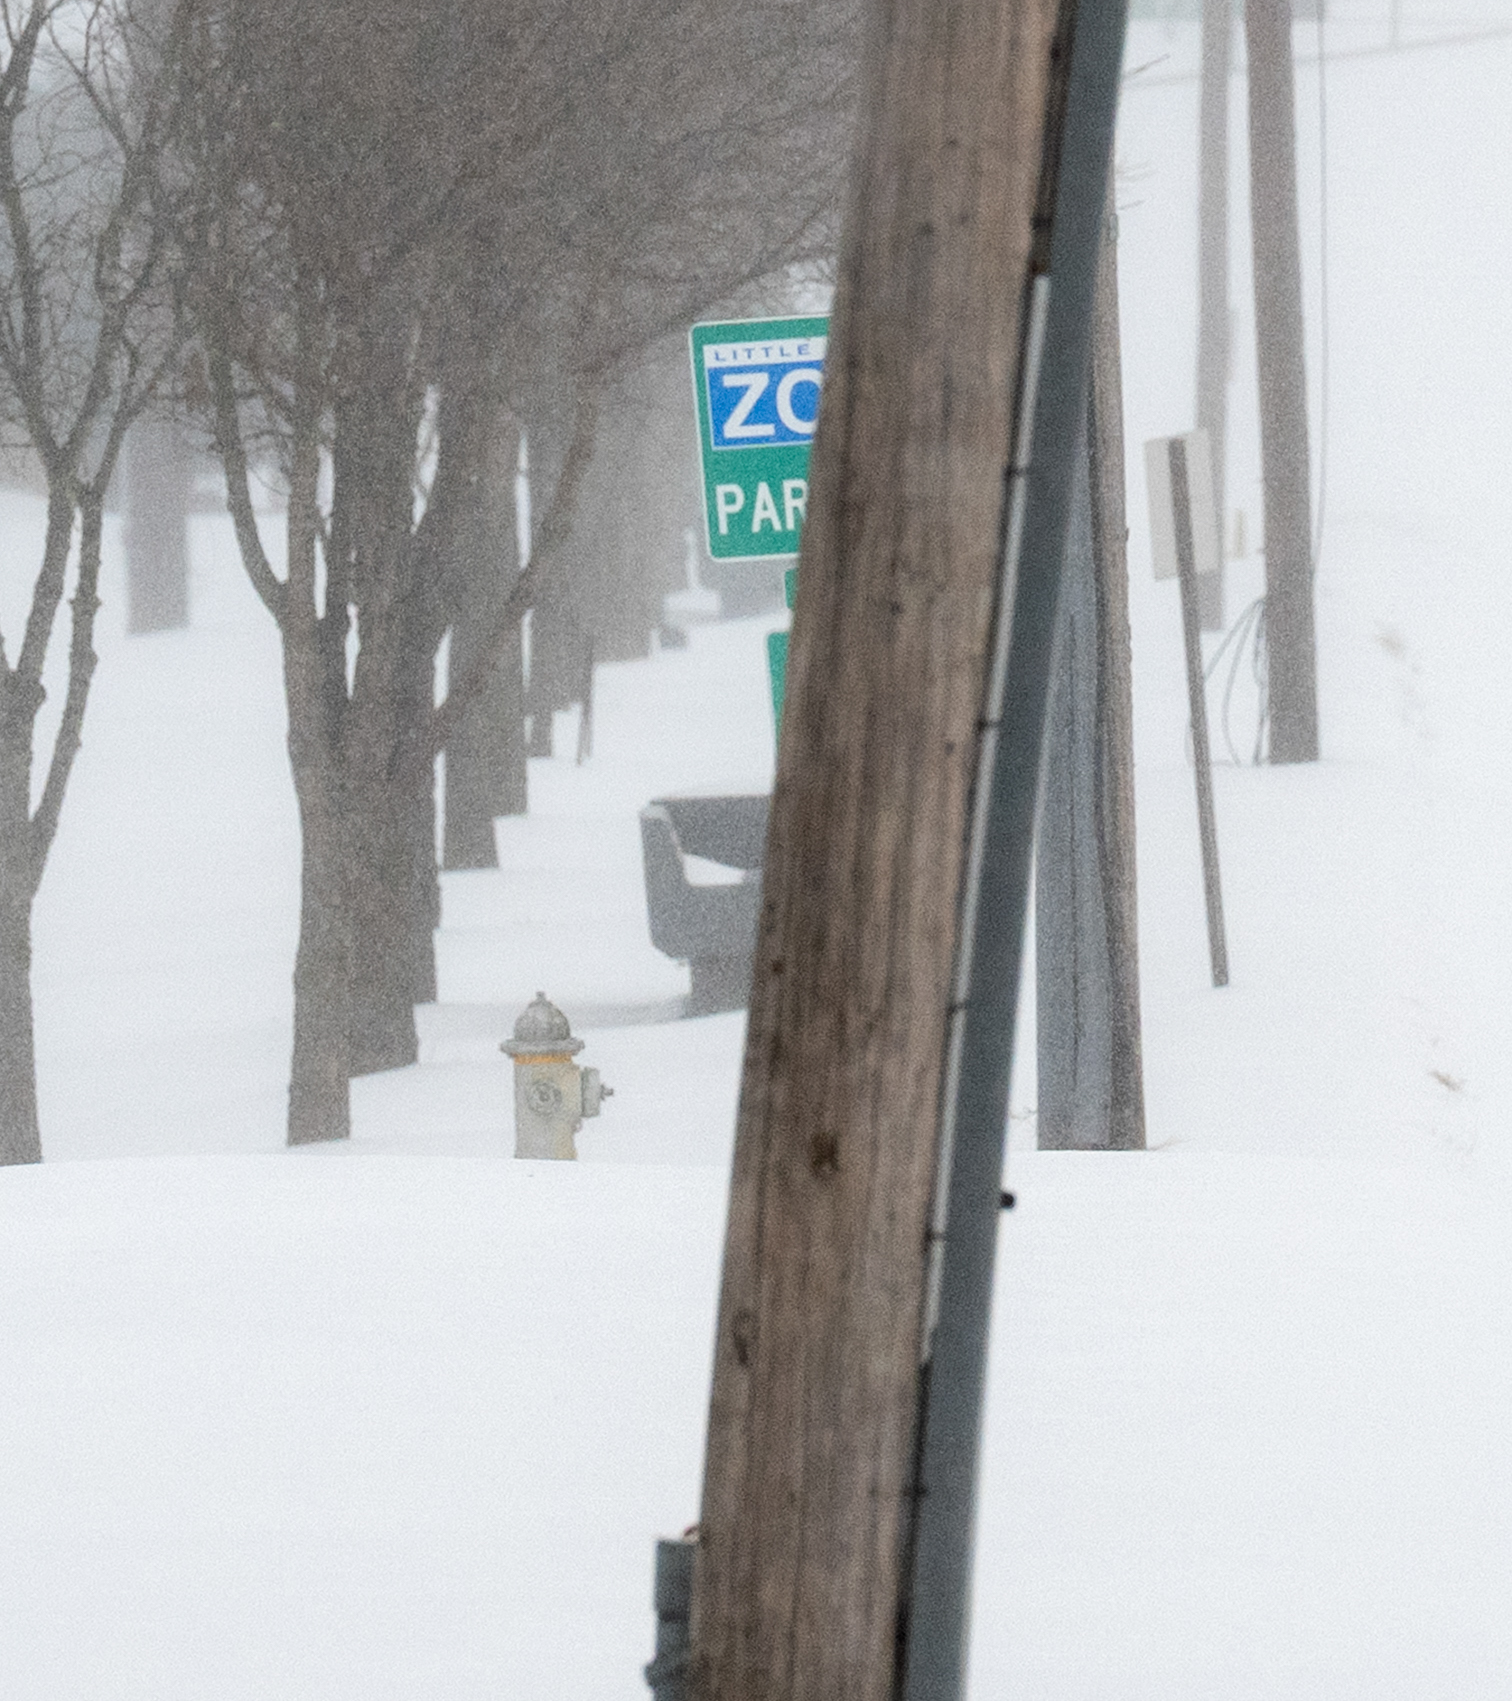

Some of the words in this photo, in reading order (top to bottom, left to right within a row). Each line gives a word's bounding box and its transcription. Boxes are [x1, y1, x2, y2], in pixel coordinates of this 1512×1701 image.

[714, 343, 811, 362] LITTLE
[722, 368, 824, 440] ZO
[715, 479, 810, 536] PAR
